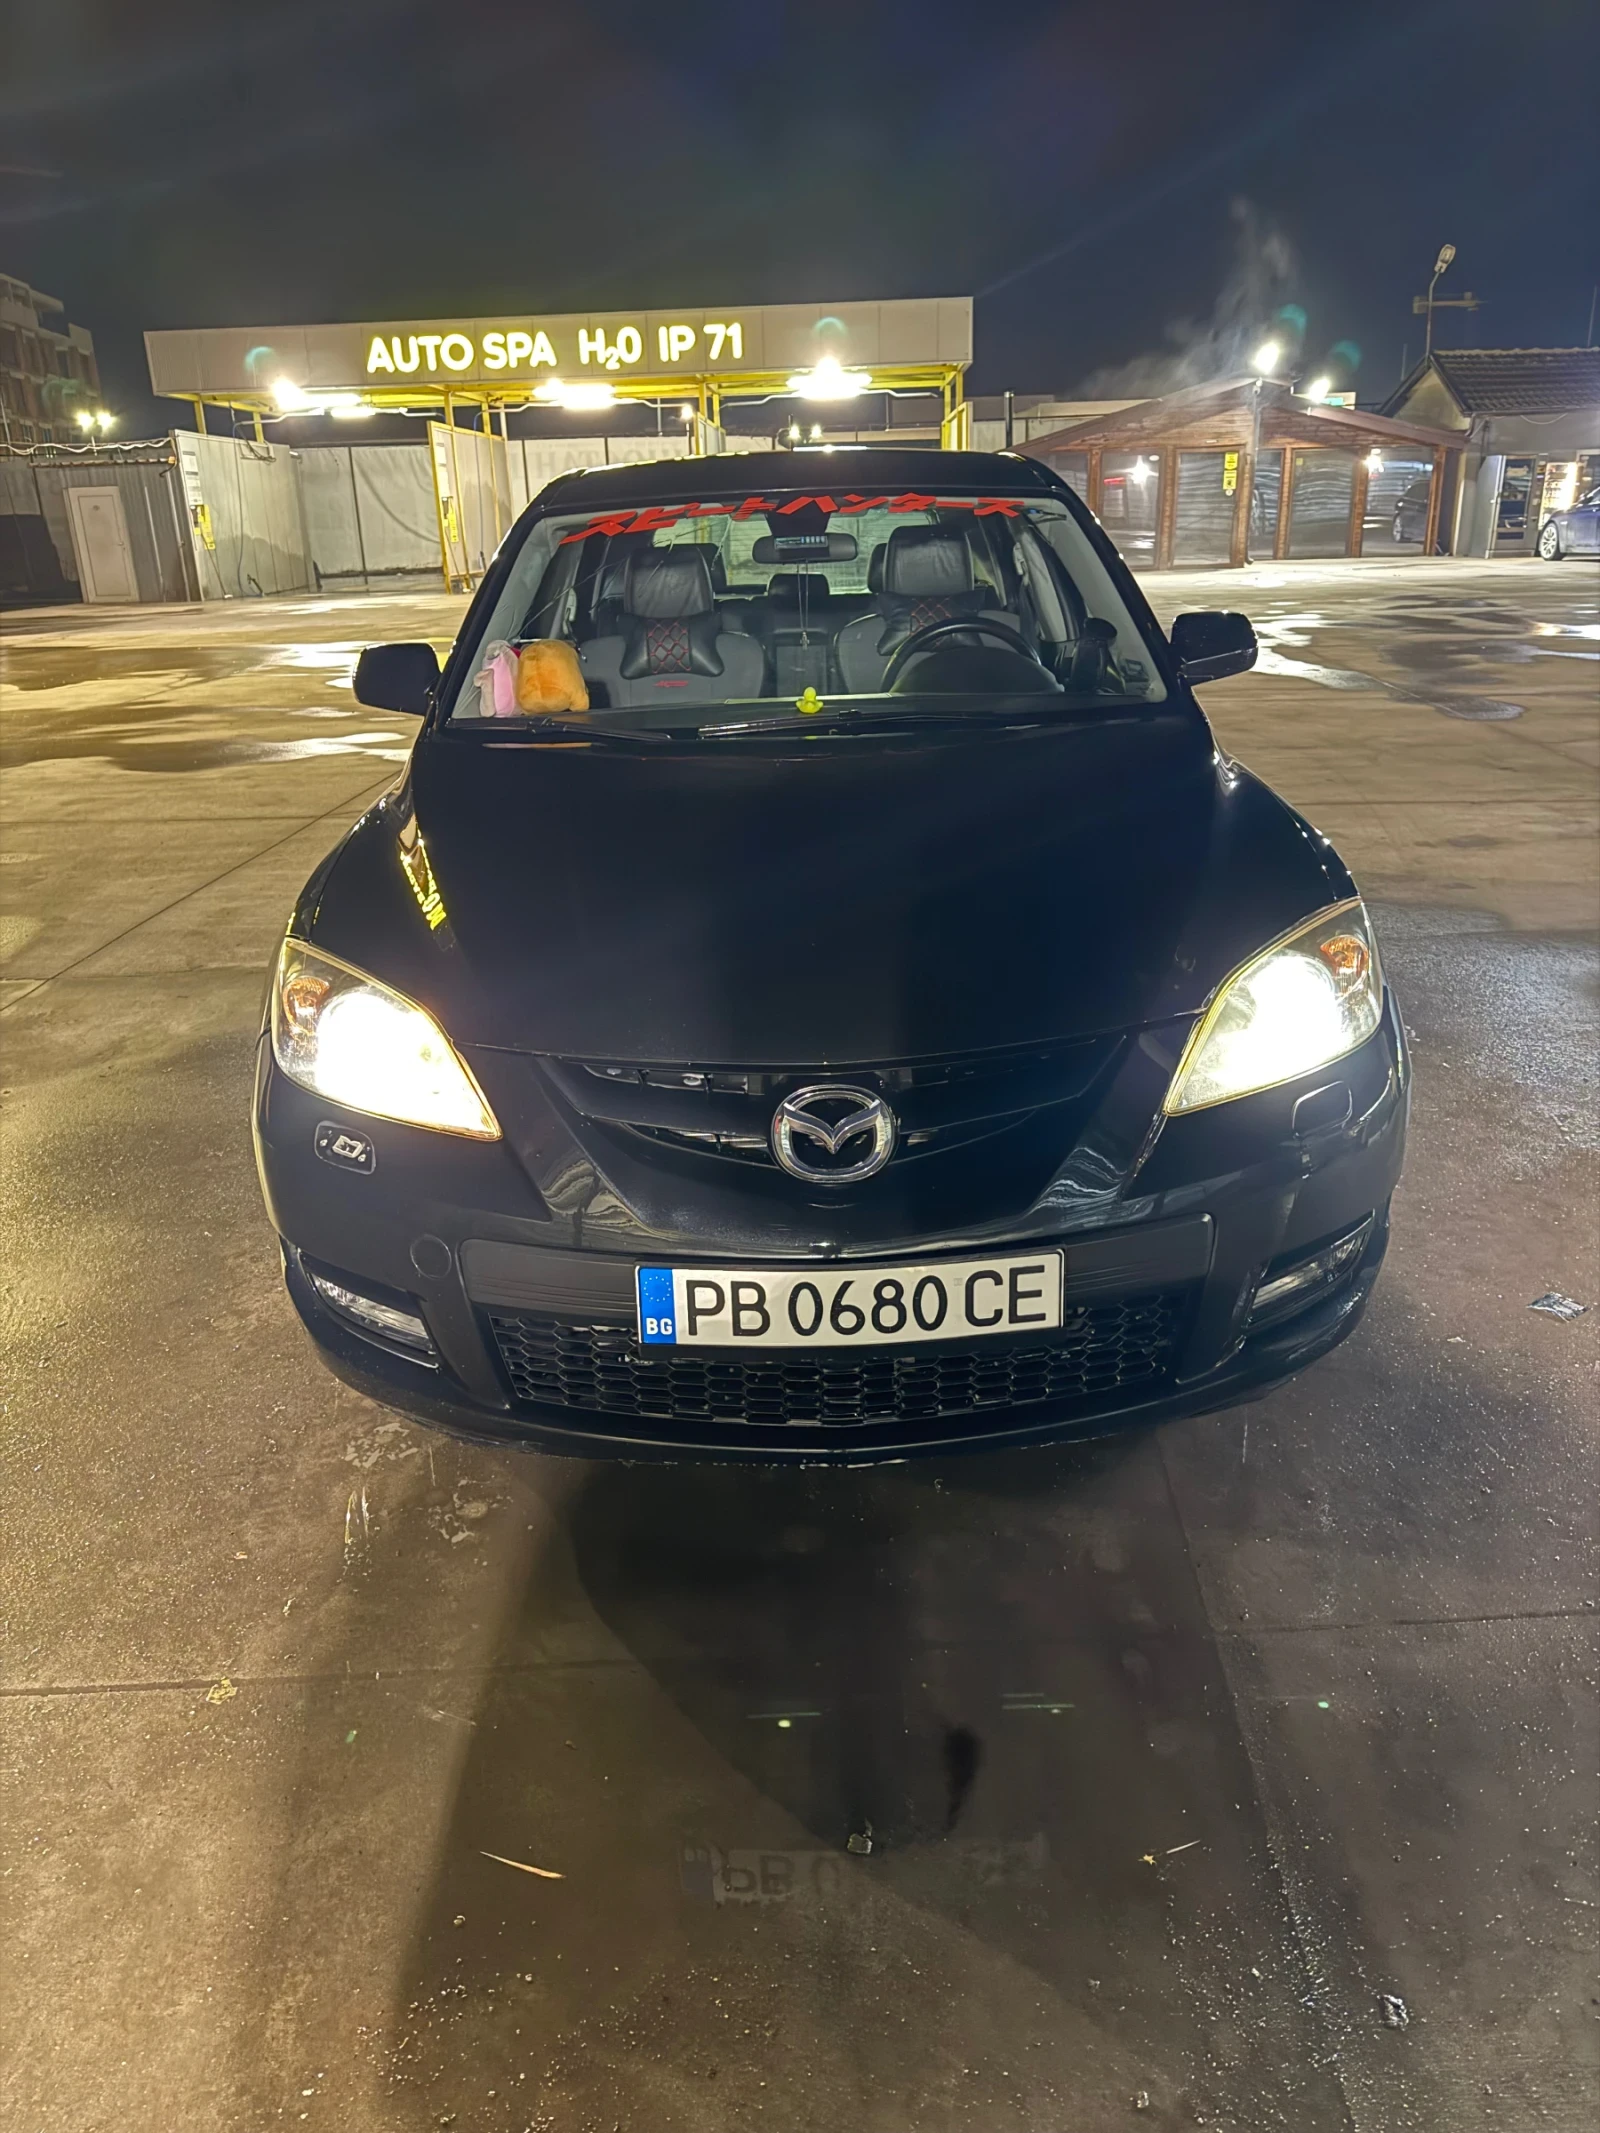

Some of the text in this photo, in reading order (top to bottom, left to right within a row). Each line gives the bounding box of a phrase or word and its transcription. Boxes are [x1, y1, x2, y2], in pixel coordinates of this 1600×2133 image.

[367, 333, 474, 374] AUTO
[482, 331, 557, 370] SPA
[658, 325, 696, 363] IP
[703, 322, 743, 360] 71
[646, 1317, 673, 1336] BG
[686, 1264, 1047, 1337] PB 0680 CE
